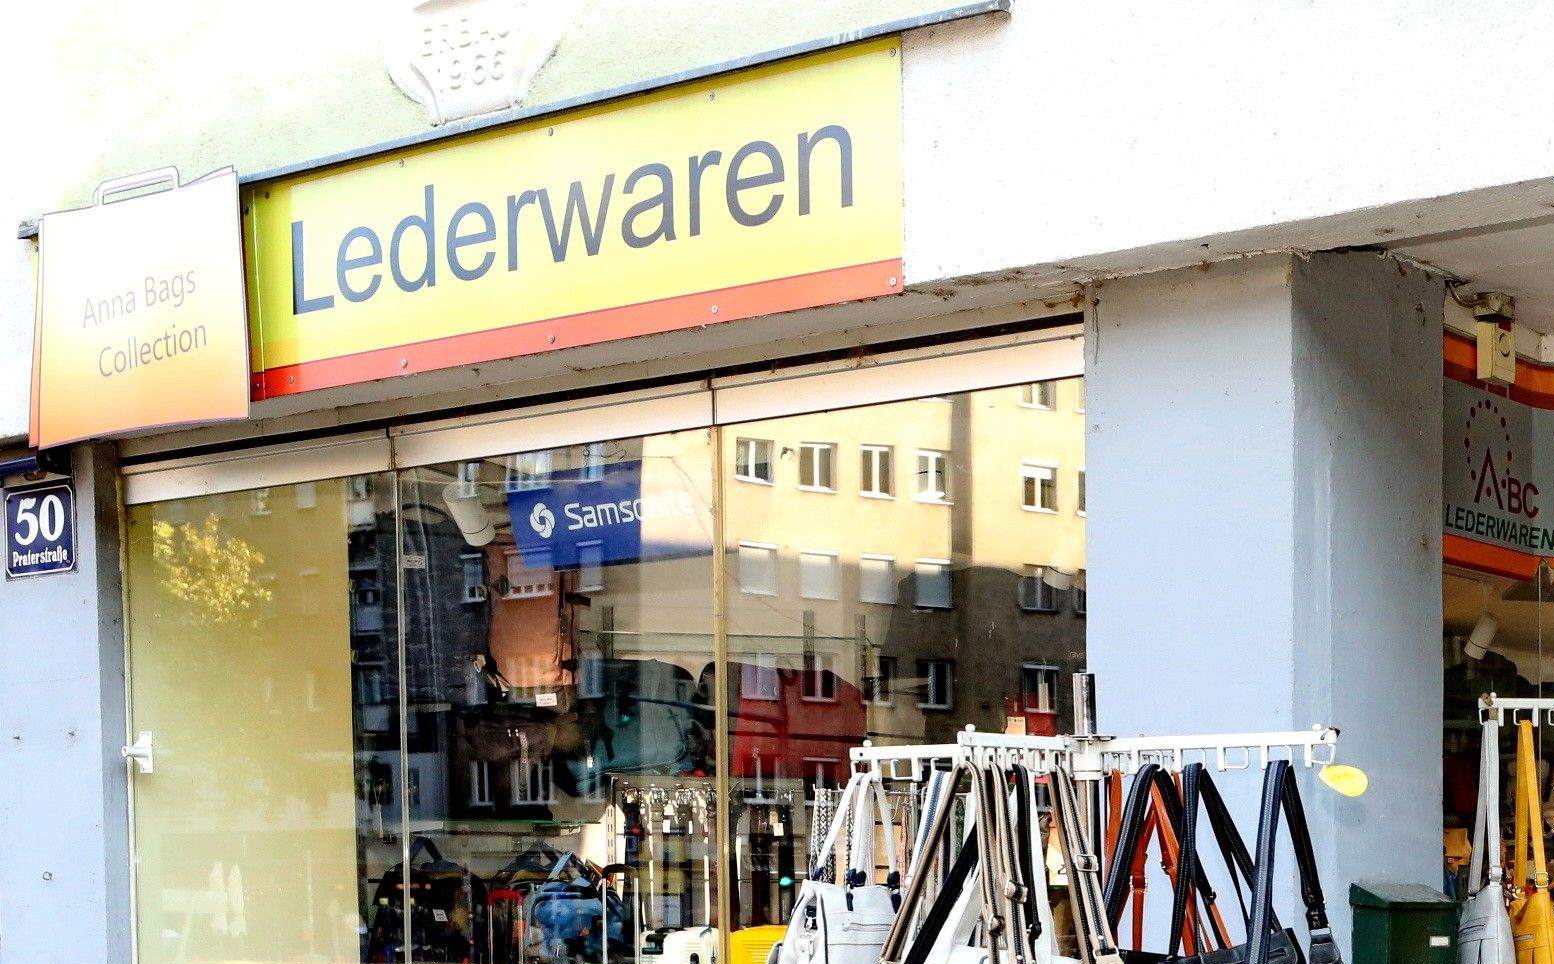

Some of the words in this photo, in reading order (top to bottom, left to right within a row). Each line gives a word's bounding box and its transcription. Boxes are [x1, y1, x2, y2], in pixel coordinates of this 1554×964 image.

[291, 123, 853, 316] Lederwaren
[83, 290, 136, 329] Anna
[144, 269, 196, 308] Bags
[98, 323, 207, 378] Collection
[1473, 446, 1540, 519] ABC
[14, 493, 65, 546] 50
[12, 545, 68, 568] Praterstraße
